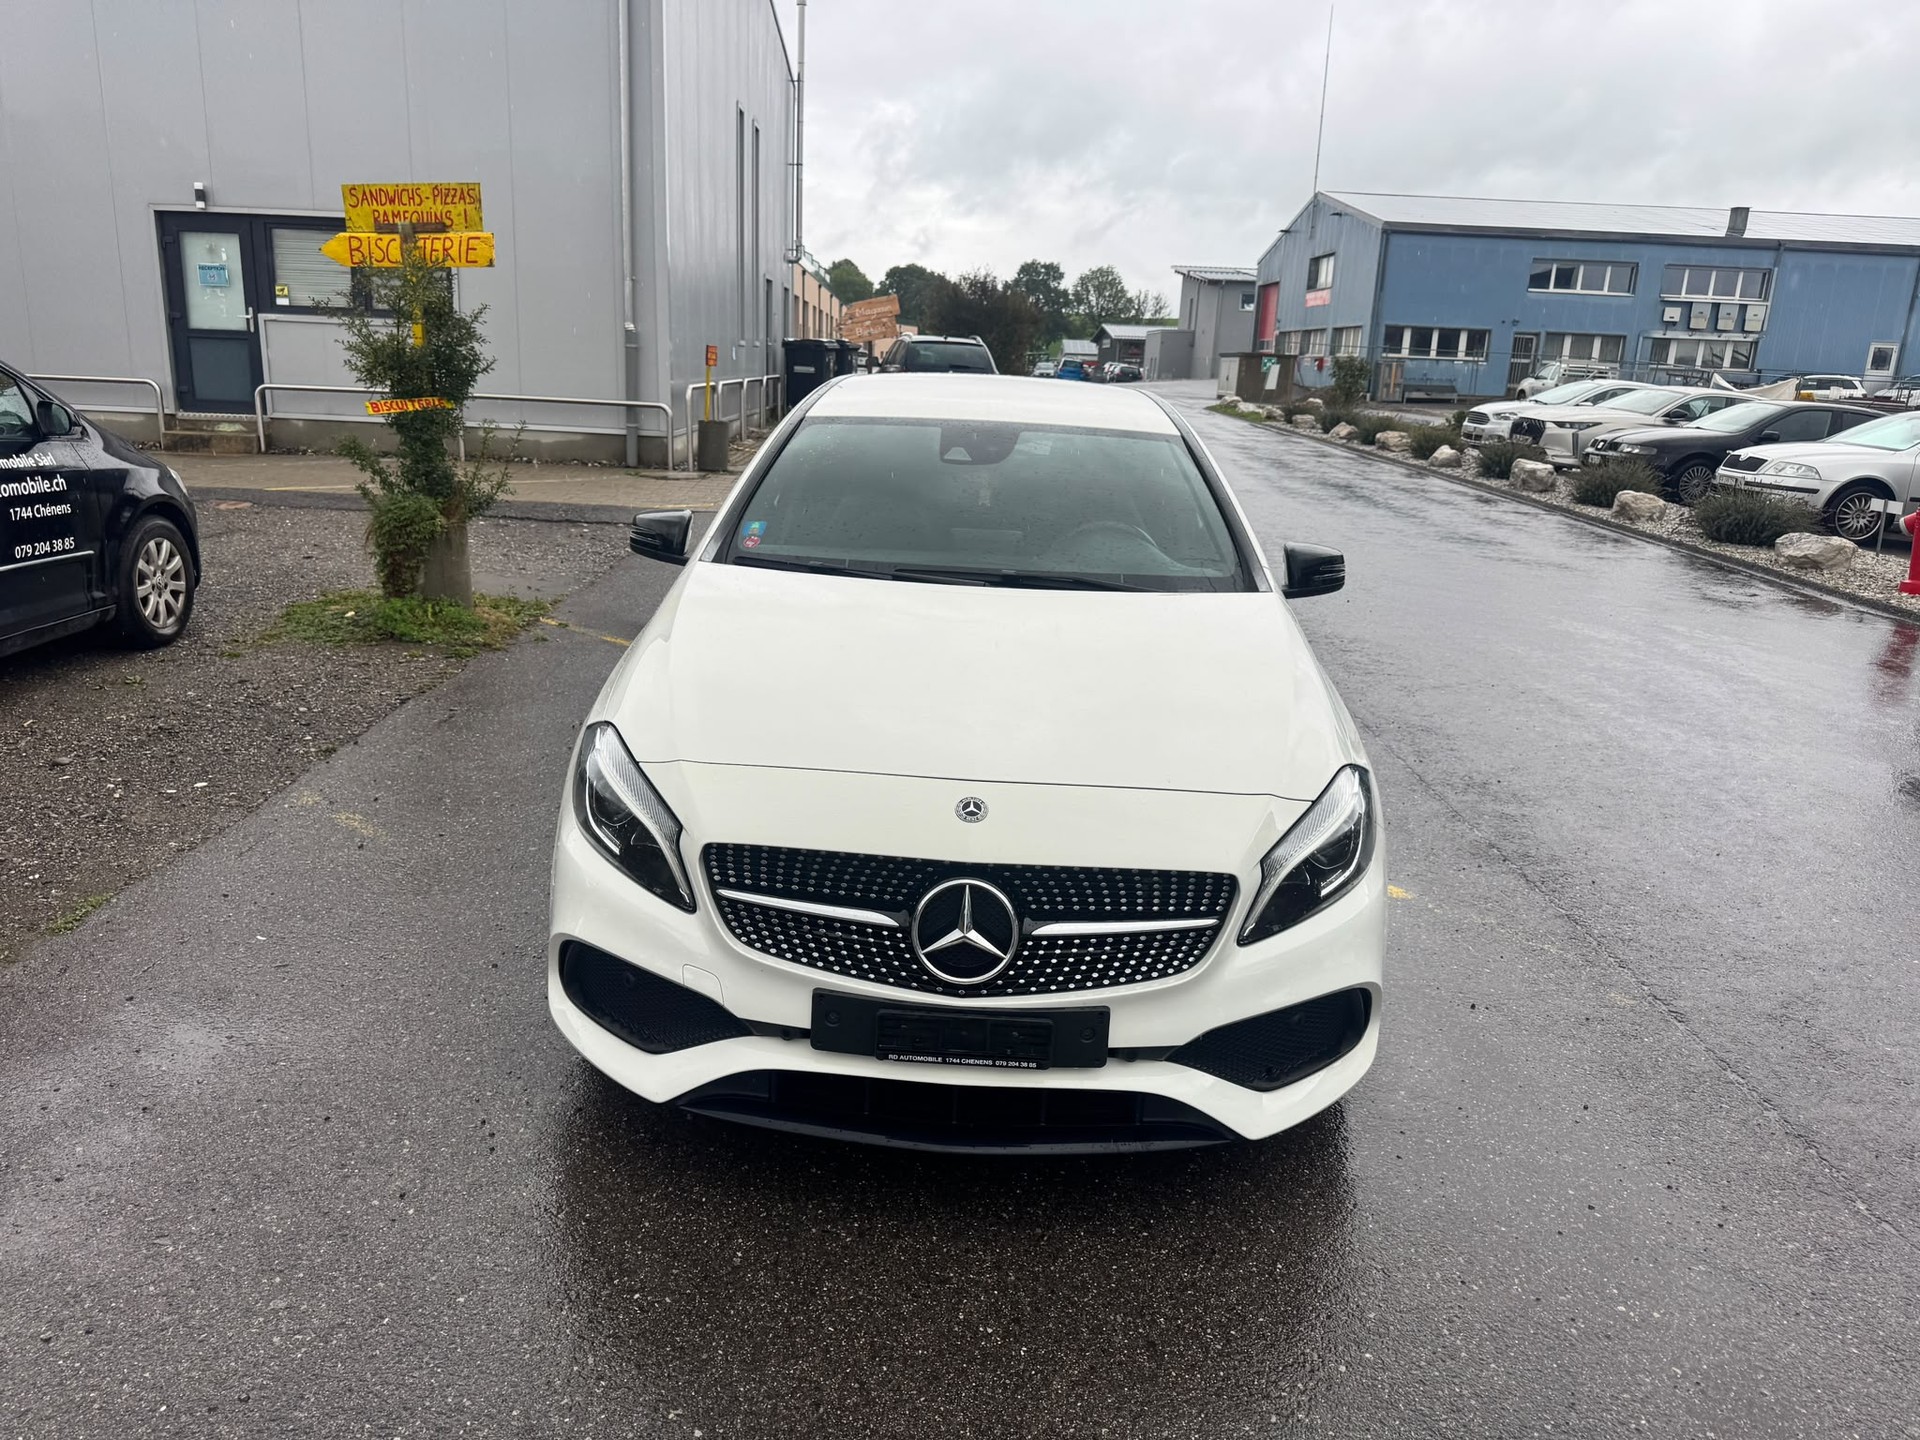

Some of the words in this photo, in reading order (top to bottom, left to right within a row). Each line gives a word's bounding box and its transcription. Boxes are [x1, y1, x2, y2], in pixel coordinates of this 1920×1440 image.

[348, 235, 481, 266] BISCTERIE
[0, 453, 36, 469] mobile
[0, 473, 68, 498] omobile.ch
[9, 506, 33, 521] 1744
[33, 502, 72, 518] Chénens
[14, 543, 33, 559] 079
[34, 540, 51, 556] 204
[52, 538, 63, 552] 38
[64, 536, 75, 549] 85
[899, 1054, 943, 1063] AUTOMOBILE
[960, 1058, 993, 1066] CHENENS
